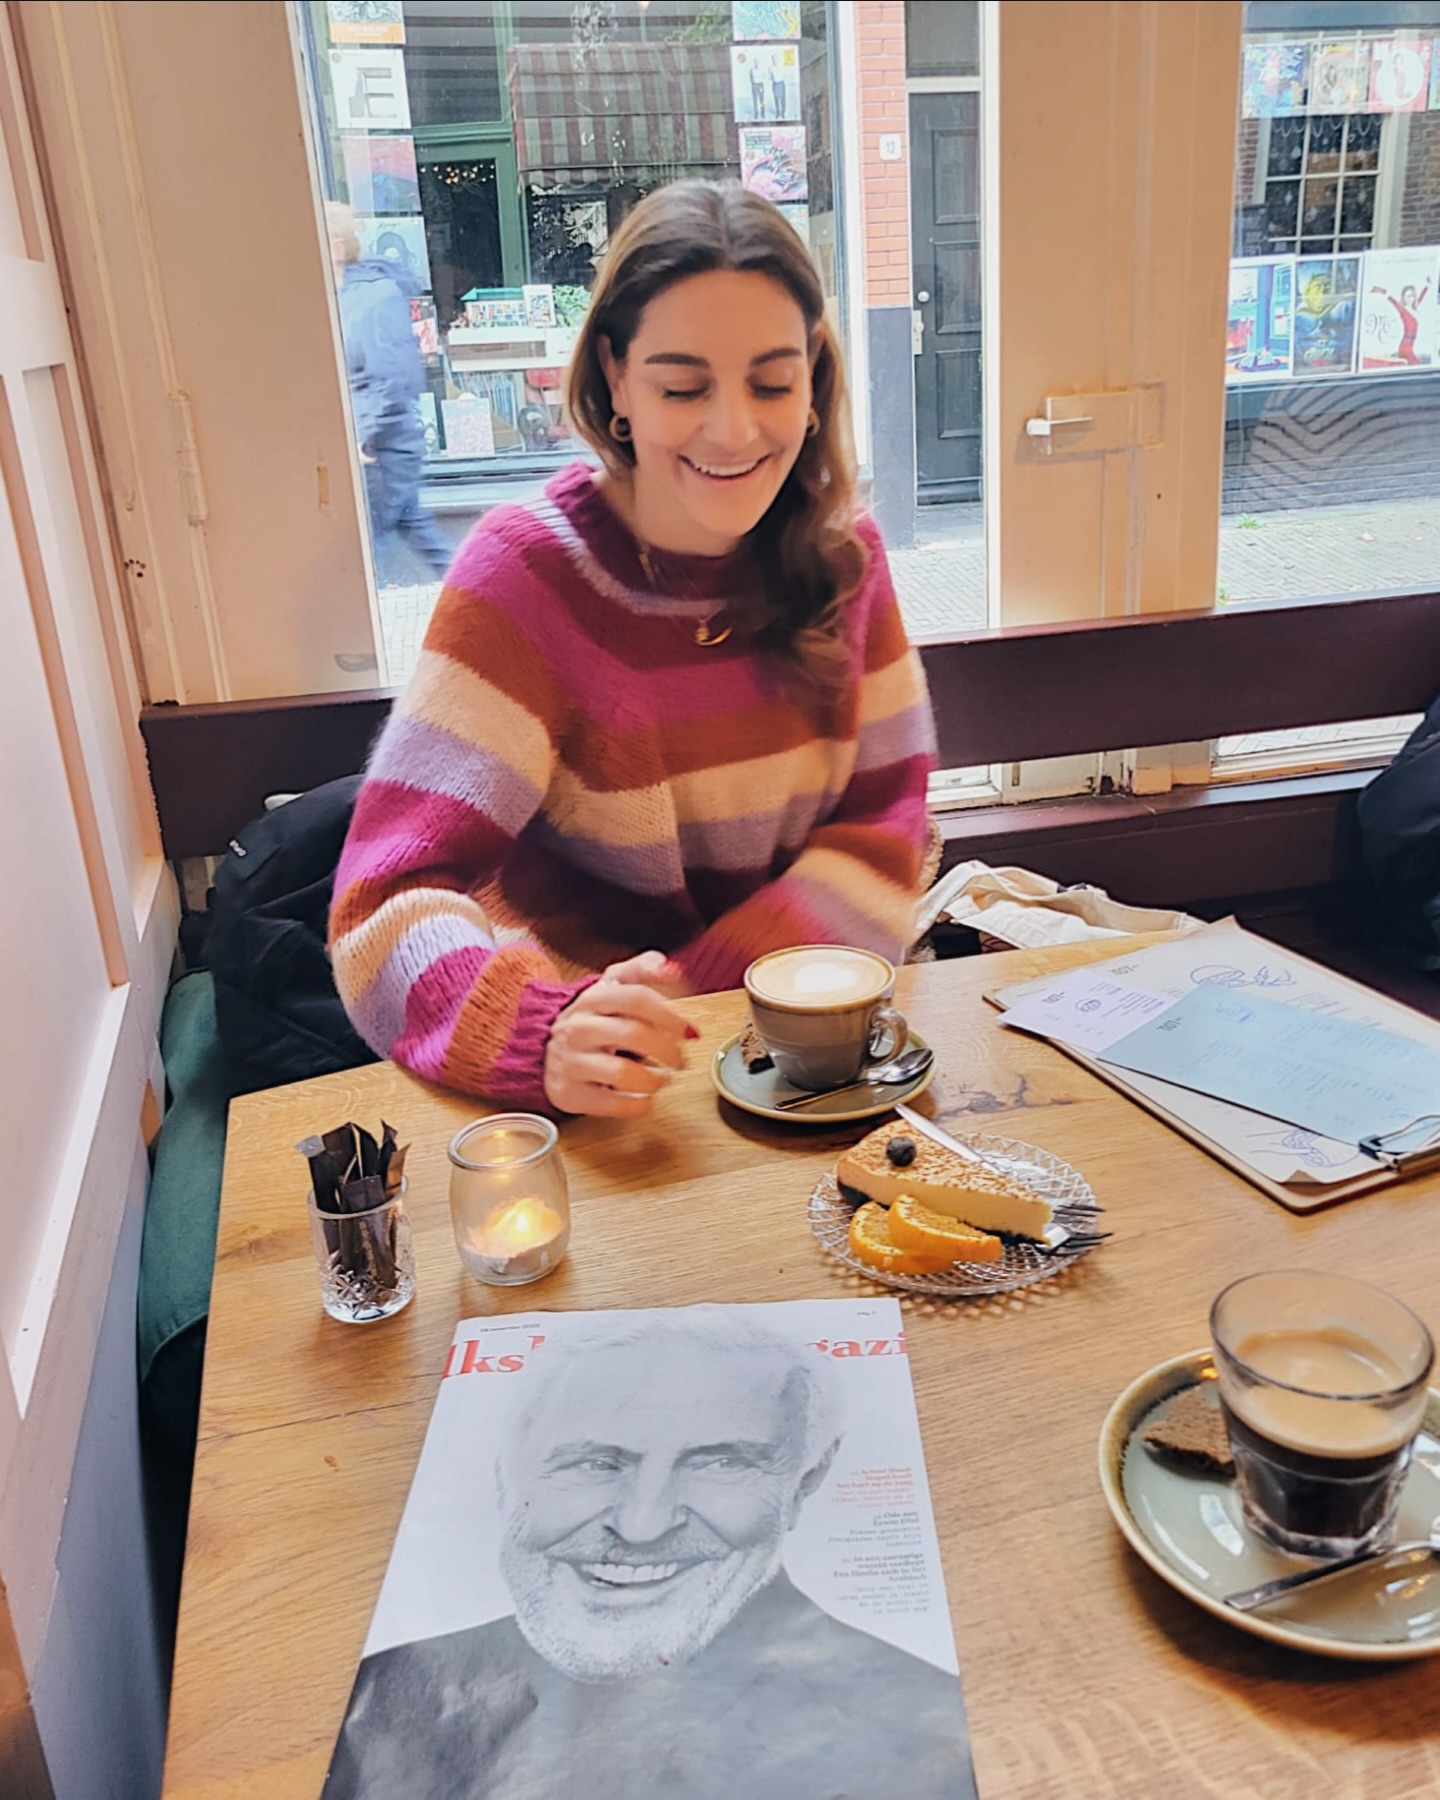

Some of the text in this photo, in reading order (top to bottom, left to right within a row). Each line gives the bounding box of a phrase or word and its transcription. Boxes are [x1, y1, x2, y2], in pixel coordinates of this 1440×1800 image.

[885, 141, 897, 154] 12
[441, 1332, 908, 1379] lks azi
